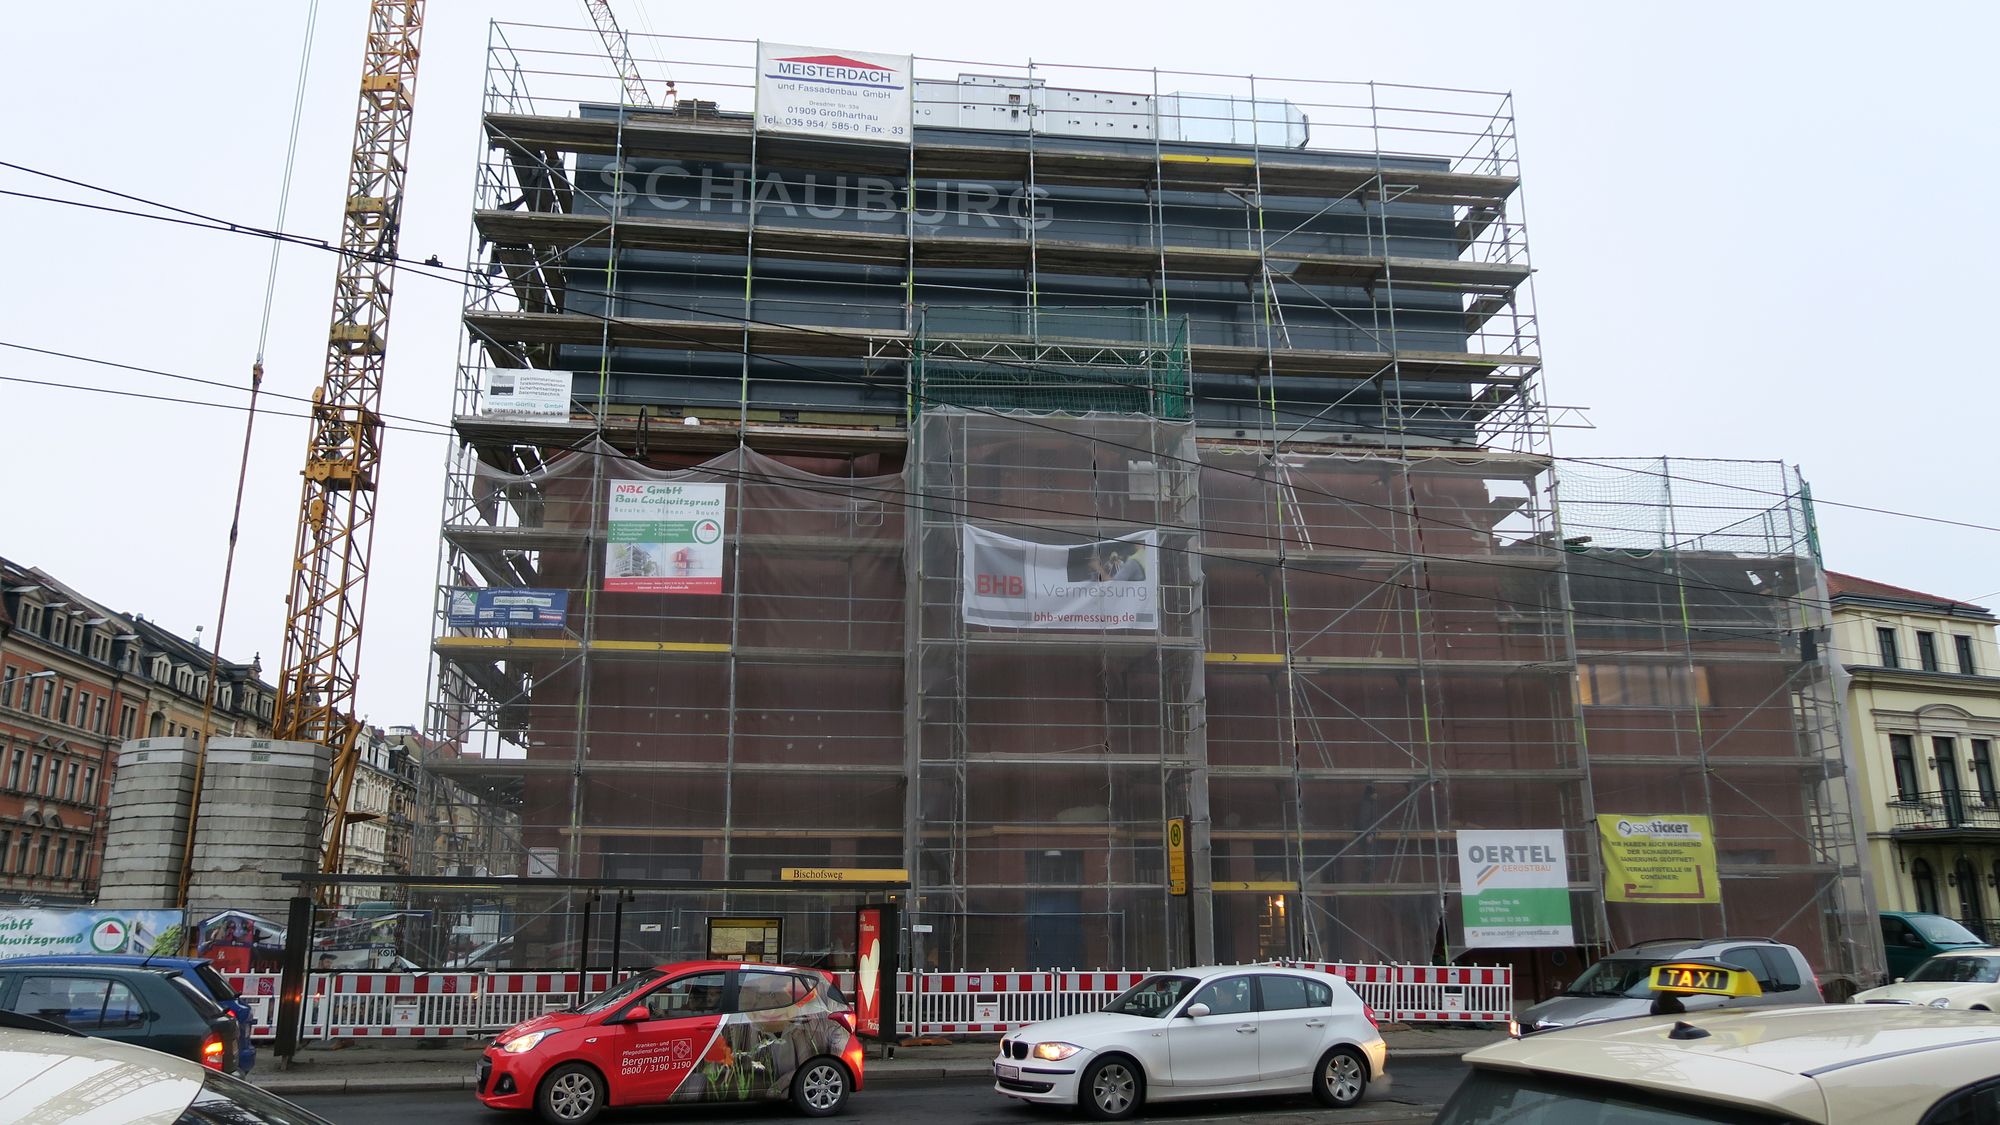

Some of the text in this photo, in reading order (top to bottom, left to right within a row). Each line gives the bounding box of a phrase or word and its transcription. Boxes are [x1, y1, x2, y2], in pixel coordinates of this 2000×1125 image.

[778, 63, 891, 83] MEISTERDACH
[778, 83, 891, 99] und Fassadenbau GmbH
[788, 106, 879, 121] 01909 Großharthau
[785, 117, 804, 126] 035
[806, 120, 828, 129] 954/
[832, 121, 860, 132] 585-0
[865, 125, 885, 134] Fax:
[600, 162, 1054, 230] SCHAUBURG
[646, 486, 683, 495] GmbH
[615, 494, 720, 507] Bau Lockwitzgrund
[977, 574, 1024, 596] BHB
[1042, 583, 1148, 601] Vermessung
[1034, 612, 1135, 624] bhb-vermessung.de
[1468, 845, 1557, 863] OERTEL
[793, 869, 843, 880] Bischofsweg
[1667, 970, 1720, 988] TAXI
[622, 1048, 653, 1056] Pflegedienst
[622, 1056, 670, 1068] Bergmann
[622, 1066, 641, 1076] 0800
[650, 1063, 670, 1072] 3190
[672, 1060, 692, 1070] 3190
